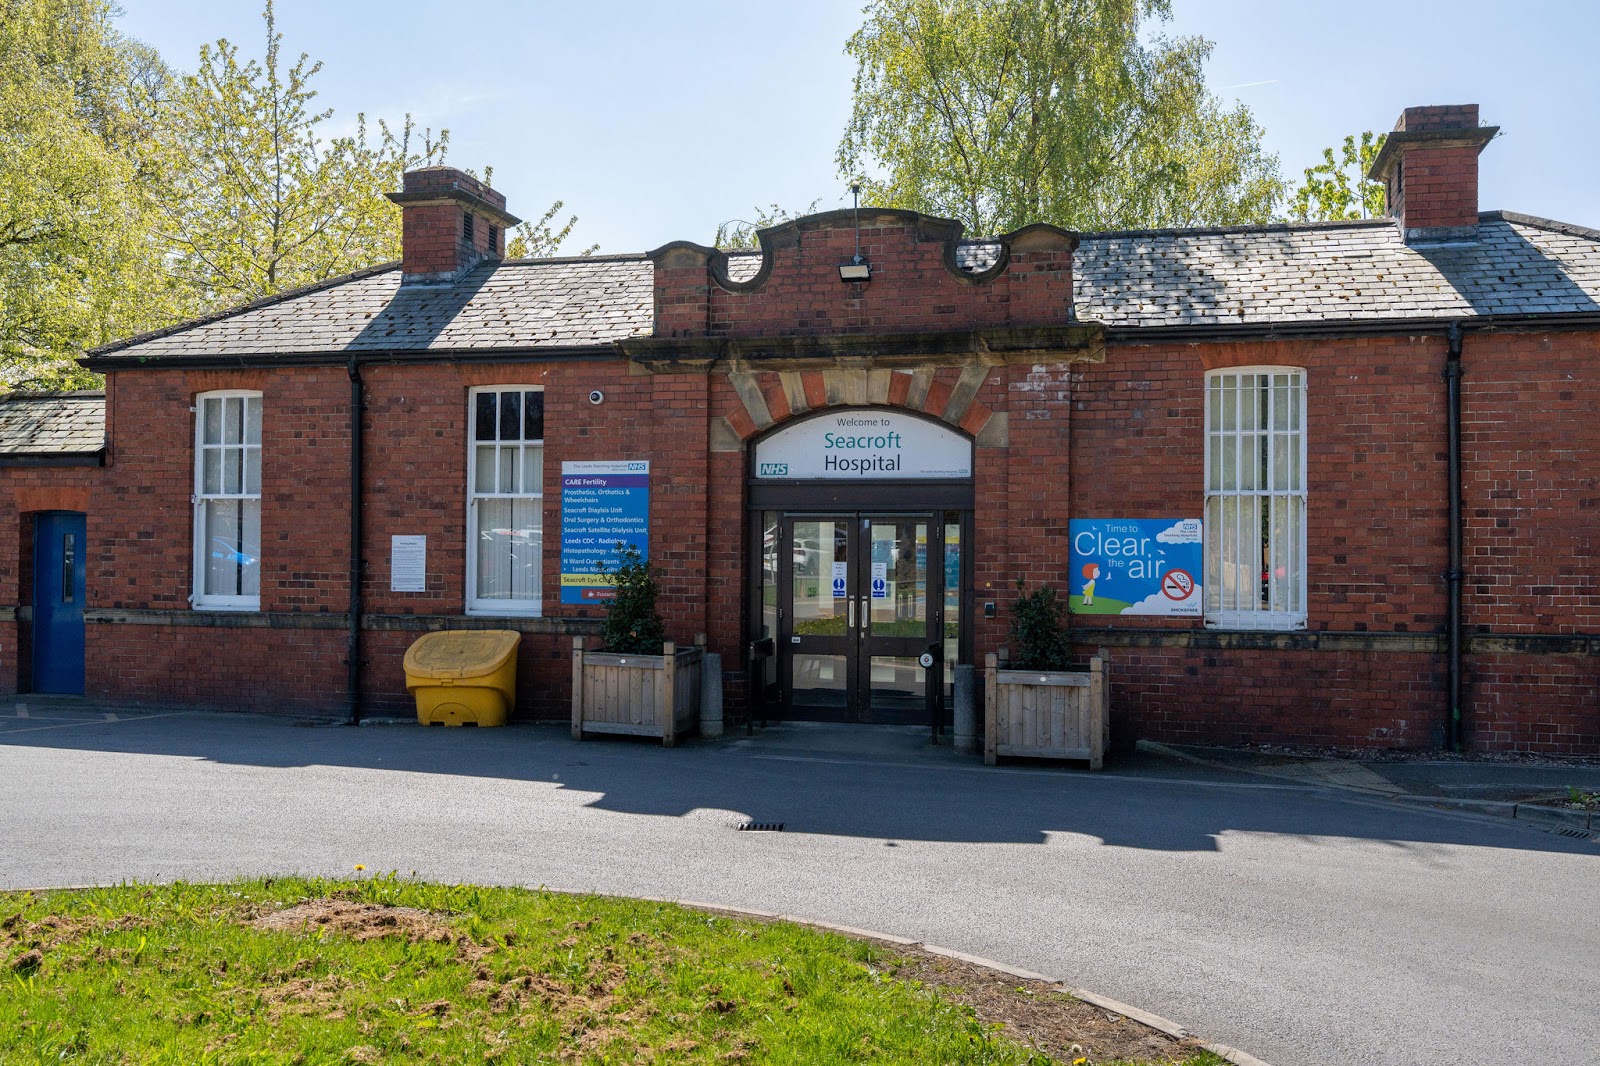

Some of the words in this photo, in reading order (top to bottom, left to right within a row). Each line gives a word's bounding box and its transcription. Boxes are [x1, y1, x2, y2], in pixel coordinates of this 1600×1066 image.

[837, 418, 878, 426] Welcome
[825, 432, 901, 448] Seacroft
[762, 464, 787, 474] NHS
[825, 454, 900, 474] Hospital
[1105, 524, 1127, 533] Time
[1075, 531, 1150, 556] Clear
[1108, 559, 1124, 567] the
[1128, 553, 1165, 578] air
